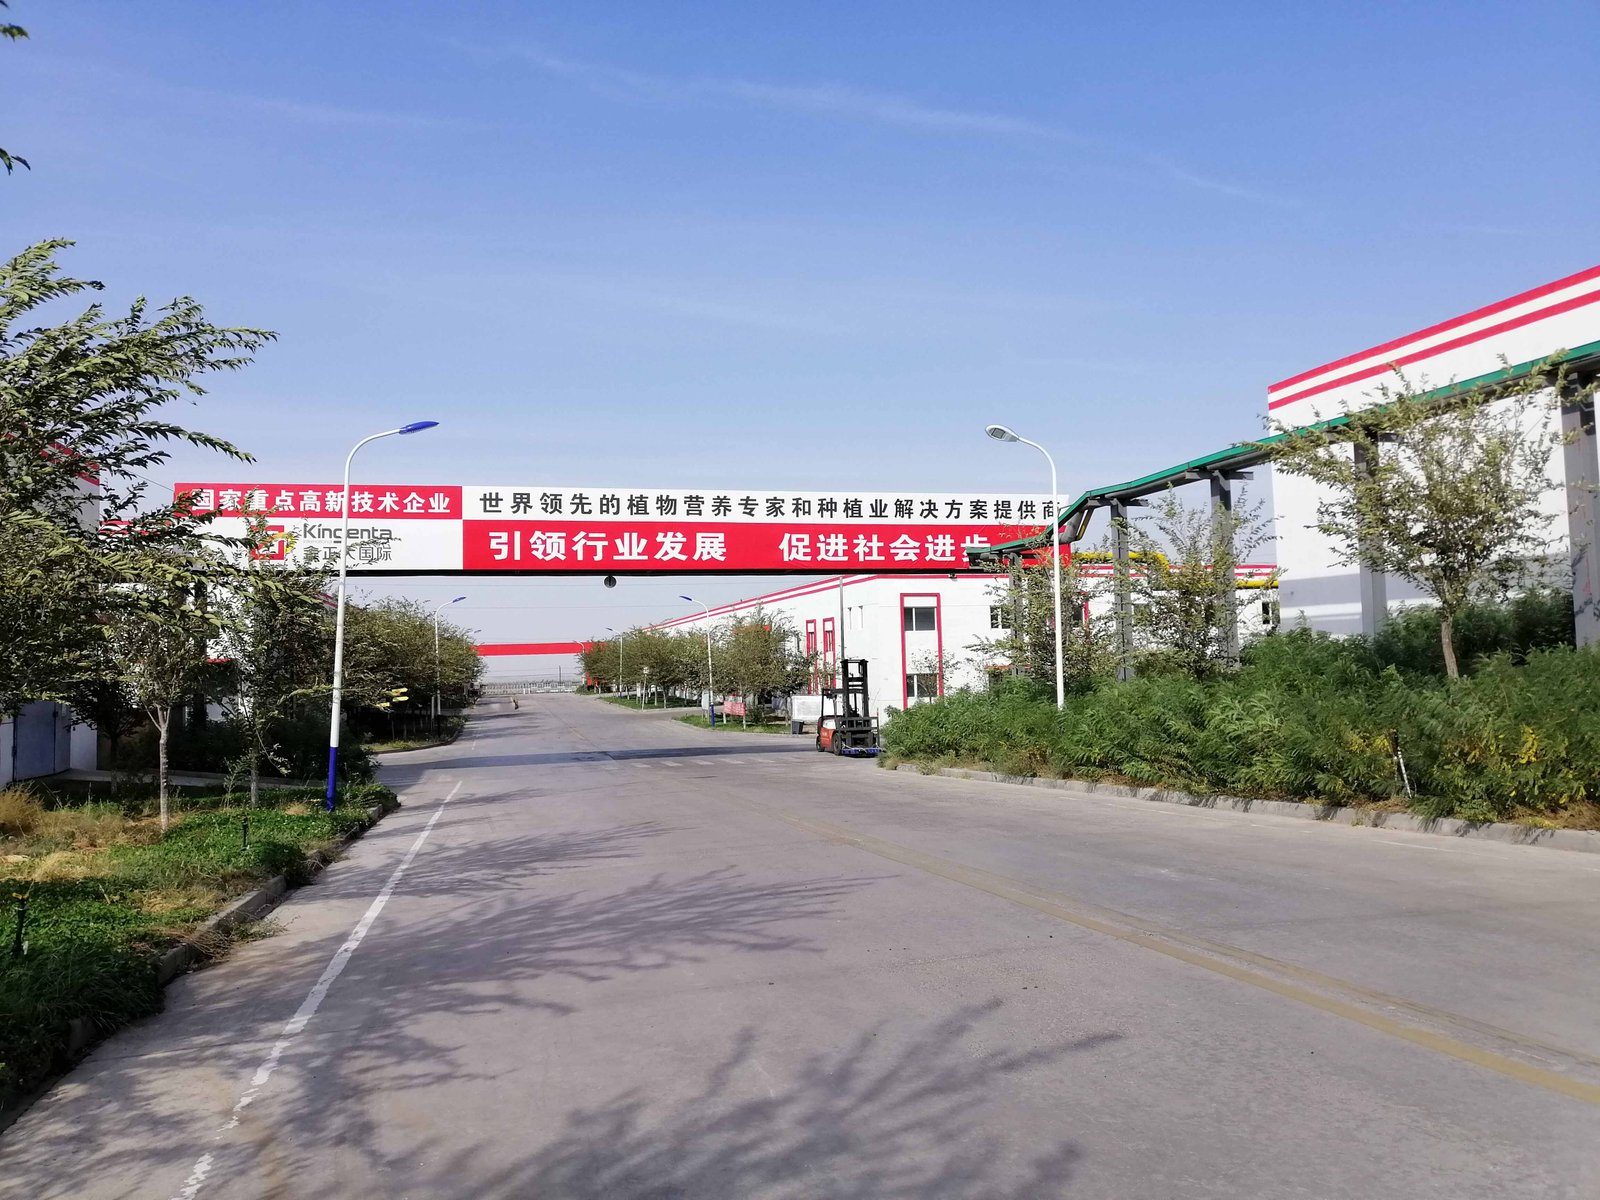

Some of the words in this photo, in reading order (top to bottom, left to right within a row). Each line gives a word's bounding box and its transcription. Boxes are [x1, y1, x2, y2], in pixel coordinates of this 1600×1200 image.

[191, 489, 451, 513] 国家重点高新技术企业
[479, 491, 1060, 520] 世界领先的植物营养专家和种植业解决方案提供商
[488, 530, 727, 561] 引领行业发展
